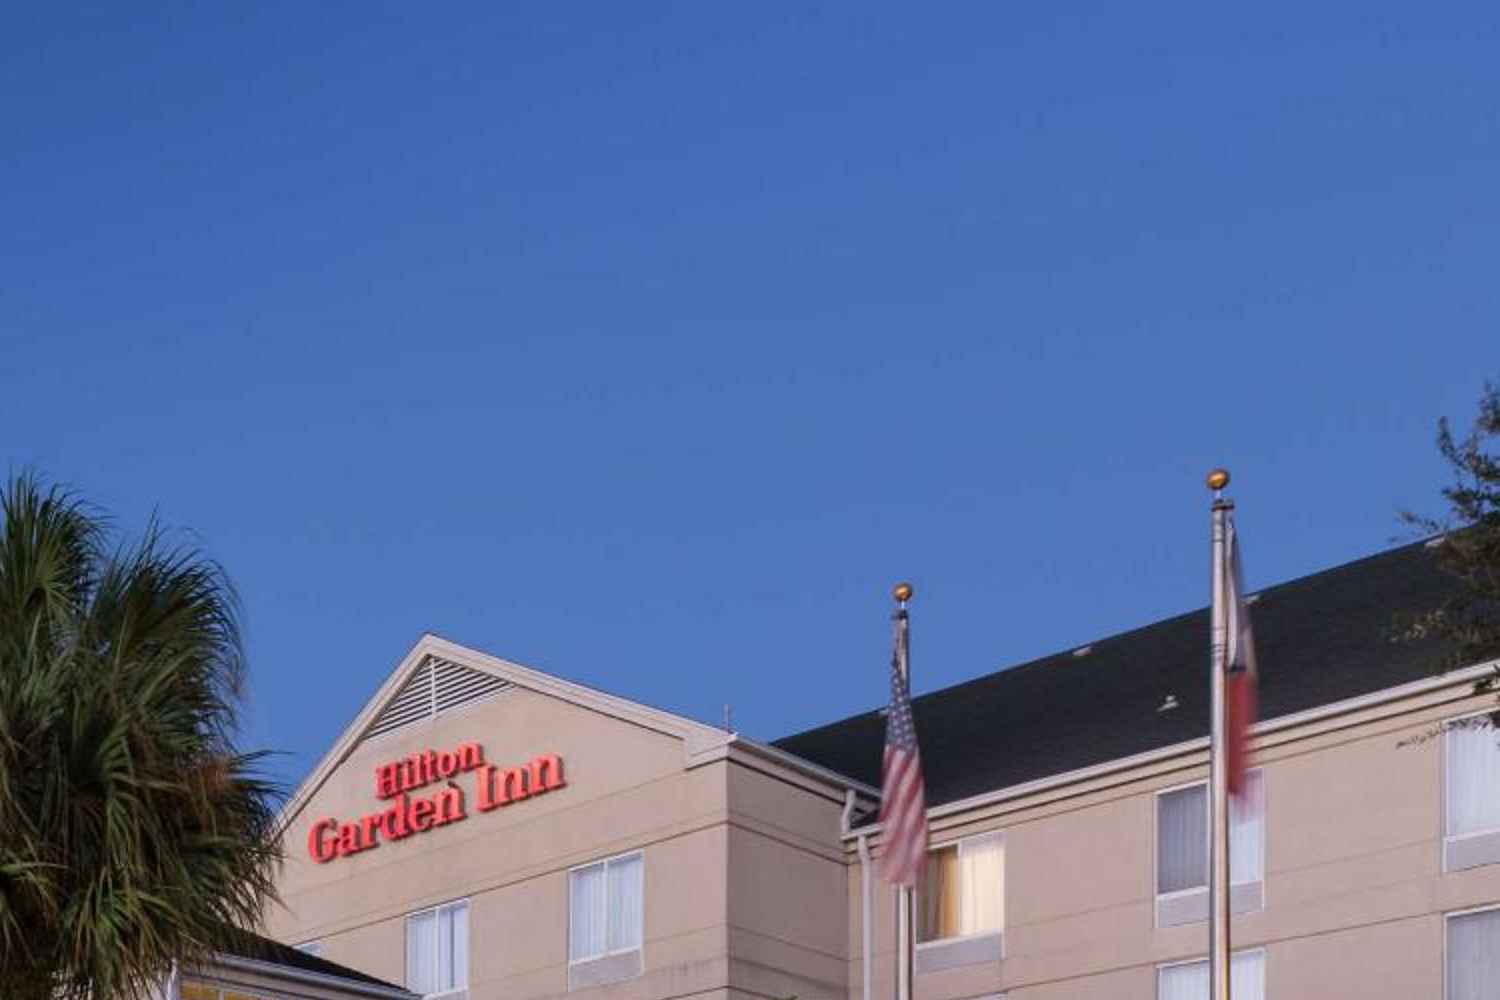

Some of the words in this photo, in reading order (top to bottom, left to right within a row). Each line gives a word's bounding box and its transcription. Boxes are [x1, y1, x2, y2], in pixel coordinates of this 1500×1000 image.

[308, 784, 468, 865] Garden
[474, 751, 567, 813] Inn
[375, 739, 485, 800] Hilton
